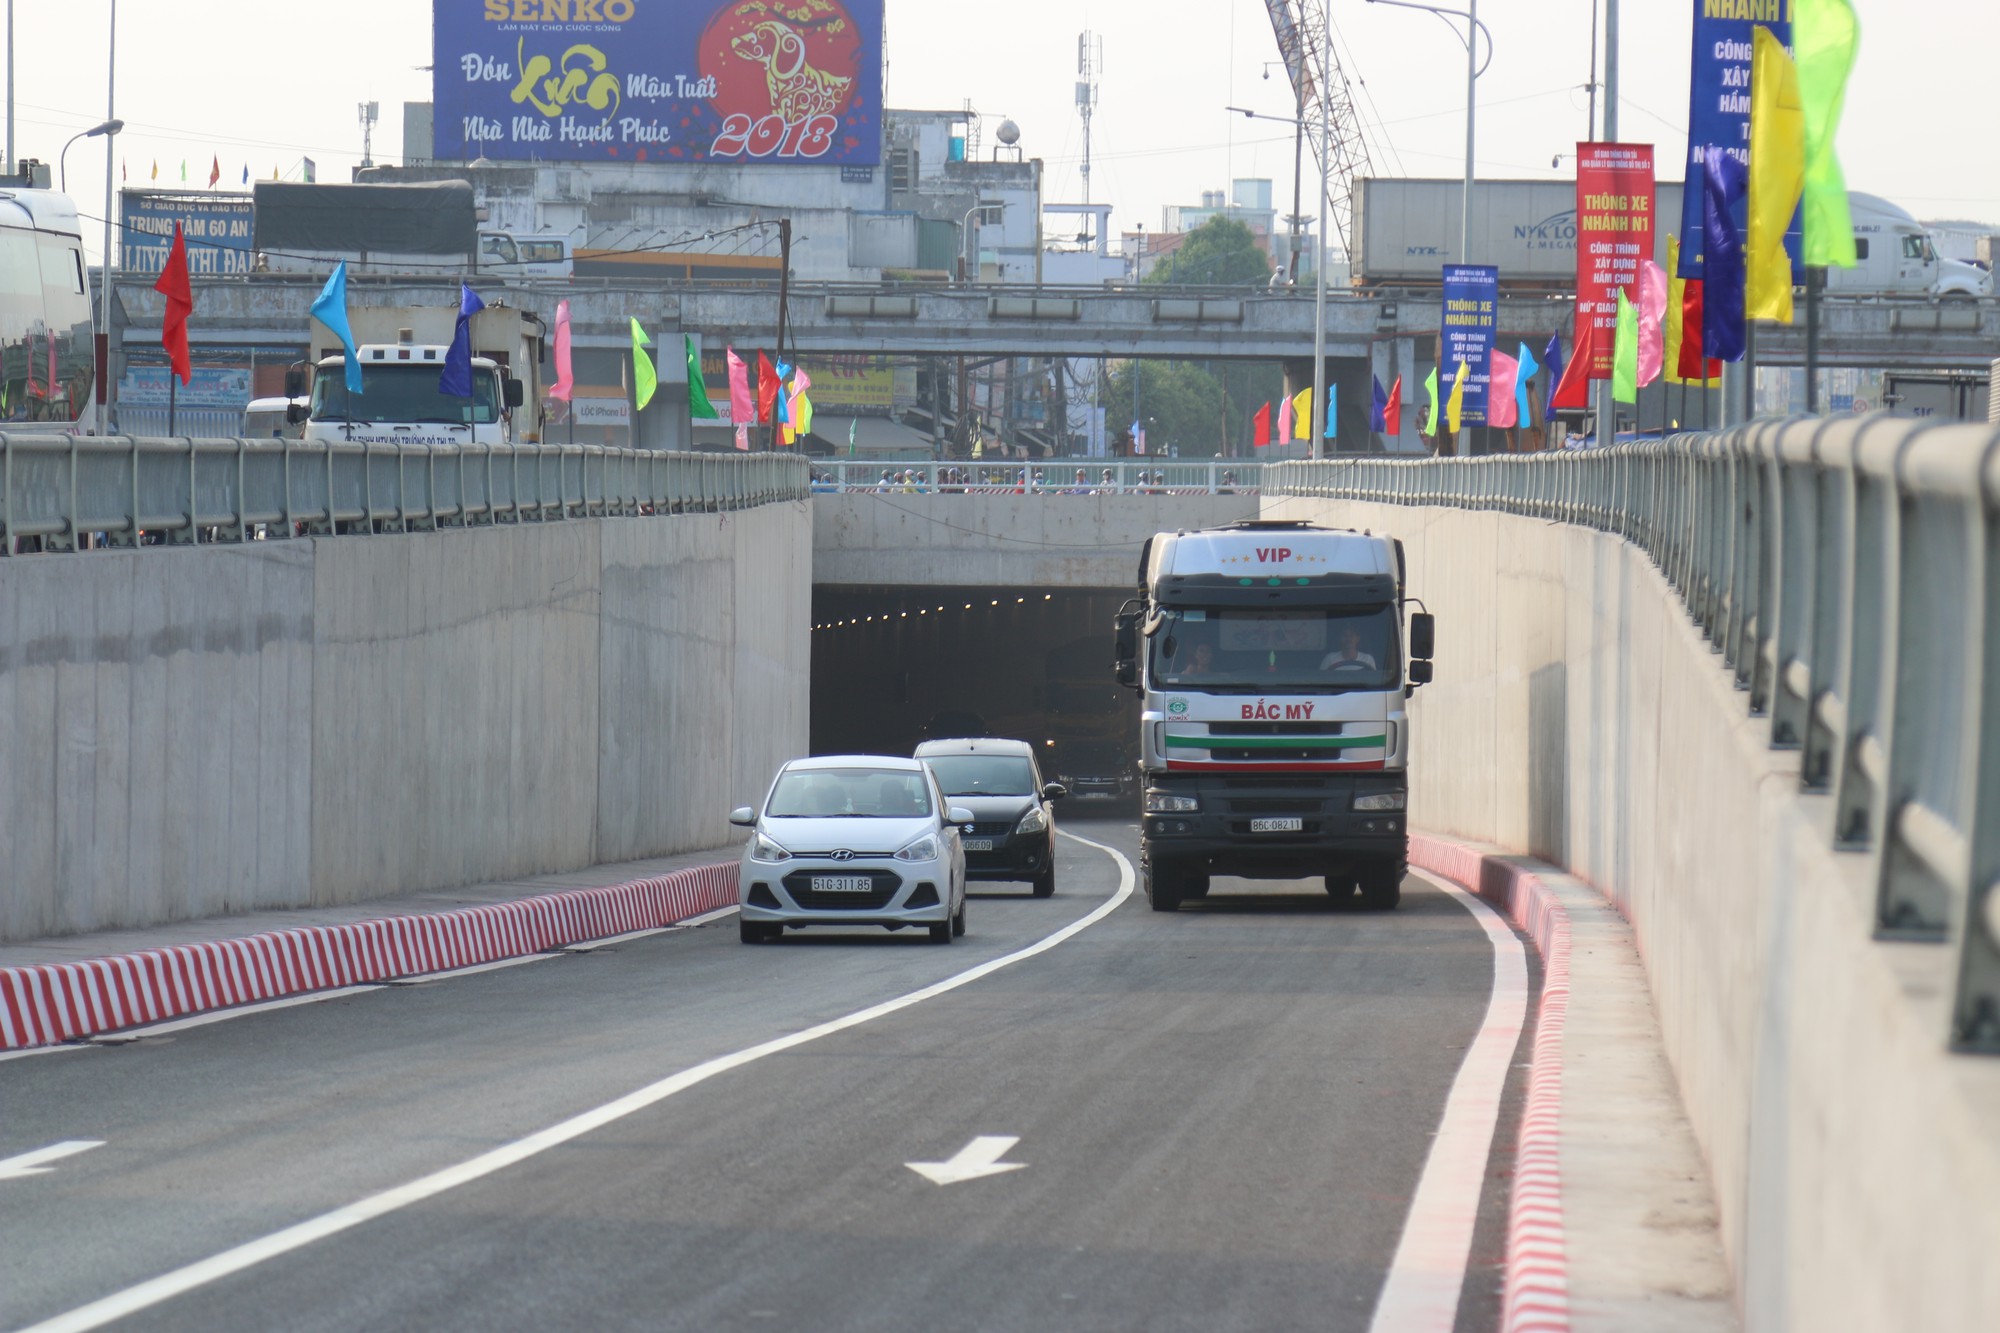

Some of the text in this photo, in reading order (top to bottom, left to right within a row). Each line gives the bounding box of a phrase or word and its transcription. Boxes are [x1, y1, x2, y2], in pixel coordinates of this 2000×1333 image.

[484, 0, 635, 22] SENKO
[542, 24, 563, 32] CHO
[1715, 38, 1752, 61] CÔNG
[461, 53, 717, 104] Đón Mậu Tuất
[1722, 65, 1750, 87] XÂY
[463, 115, 671, 147] Nhà Nhà Hạnh Phúc
[710, 113, 838, 157] 2018
[1585, 192, 1648, 211] THÔNG XE
[128, 216, 173, 235] TRUNG
[209, 219, 226, 237] 60
[230, 220, 248, 237] AN
[1583, 213, 1648, 232] NHÁNH N1
[1514, 225, 1577, 240] NYK LO
[1406, 247, 1438, 255] NYK
[1590, 242, 1640, 254] CÔNG TRÌNH
[1595, 256, 1636, 271] XÂY DỰNG
[1614, 273, 1635, 284] CHUI
[1447, 298, 1492, 312] THÔNG XE
[1446, 312, 1492, 326] NHÁNH N1
[721, 406, 731, 418] GÓ
[1256, 548, 1291, 562] VIP
[1241, 699, 1315, 720] BẮC MỸ
[814, 879, 870, 890] 51G-311.85
